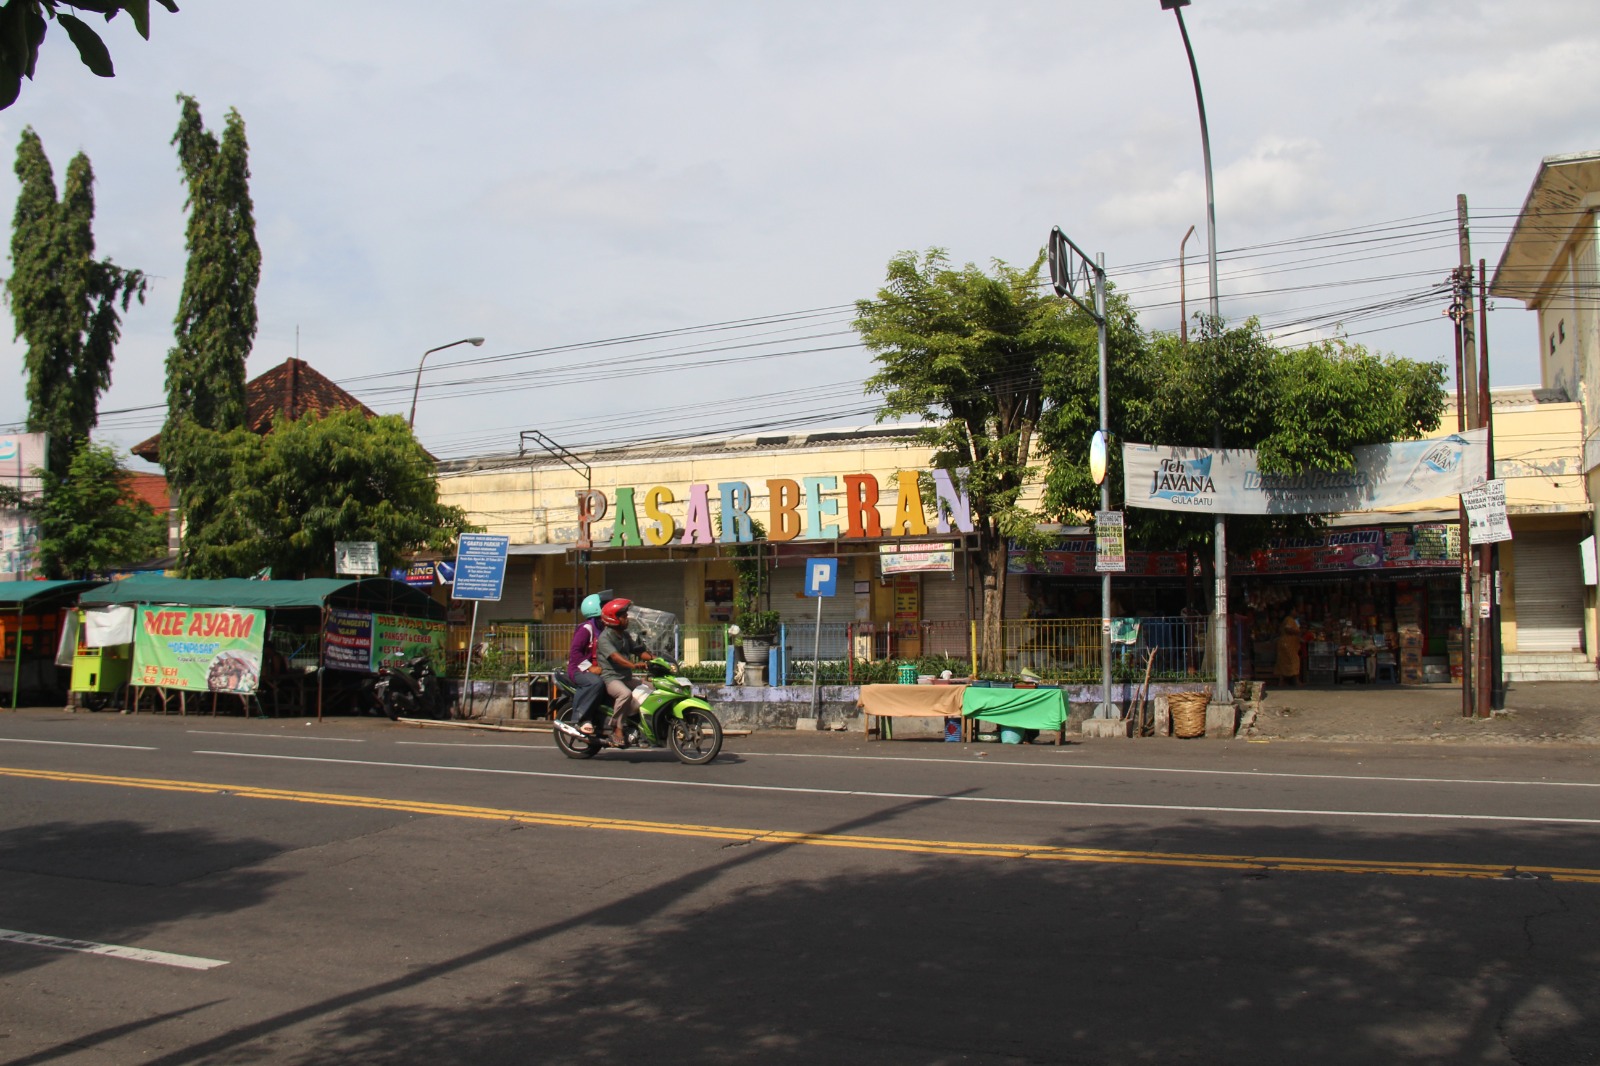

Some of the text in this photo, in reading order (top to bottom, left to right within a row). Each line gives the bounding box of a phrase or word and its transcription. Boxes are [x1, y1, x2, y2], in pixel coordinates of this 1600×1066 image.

[1161, 458, 1185, 473] Teh
[1150, 470, 1216, 494] JAVANA
[1308, 470, 1368, 489] Puasa
[575, 467, 974, 549] PASAR BERAN
[1171, 496, 1213, 506] GULA BATU
[1327, 531, 1380, 546] NGAWI
[407, 567, 434, 576] KING
[811, 563, 831, 591] P
[144, 611, 256, 638] MIE AYAM
